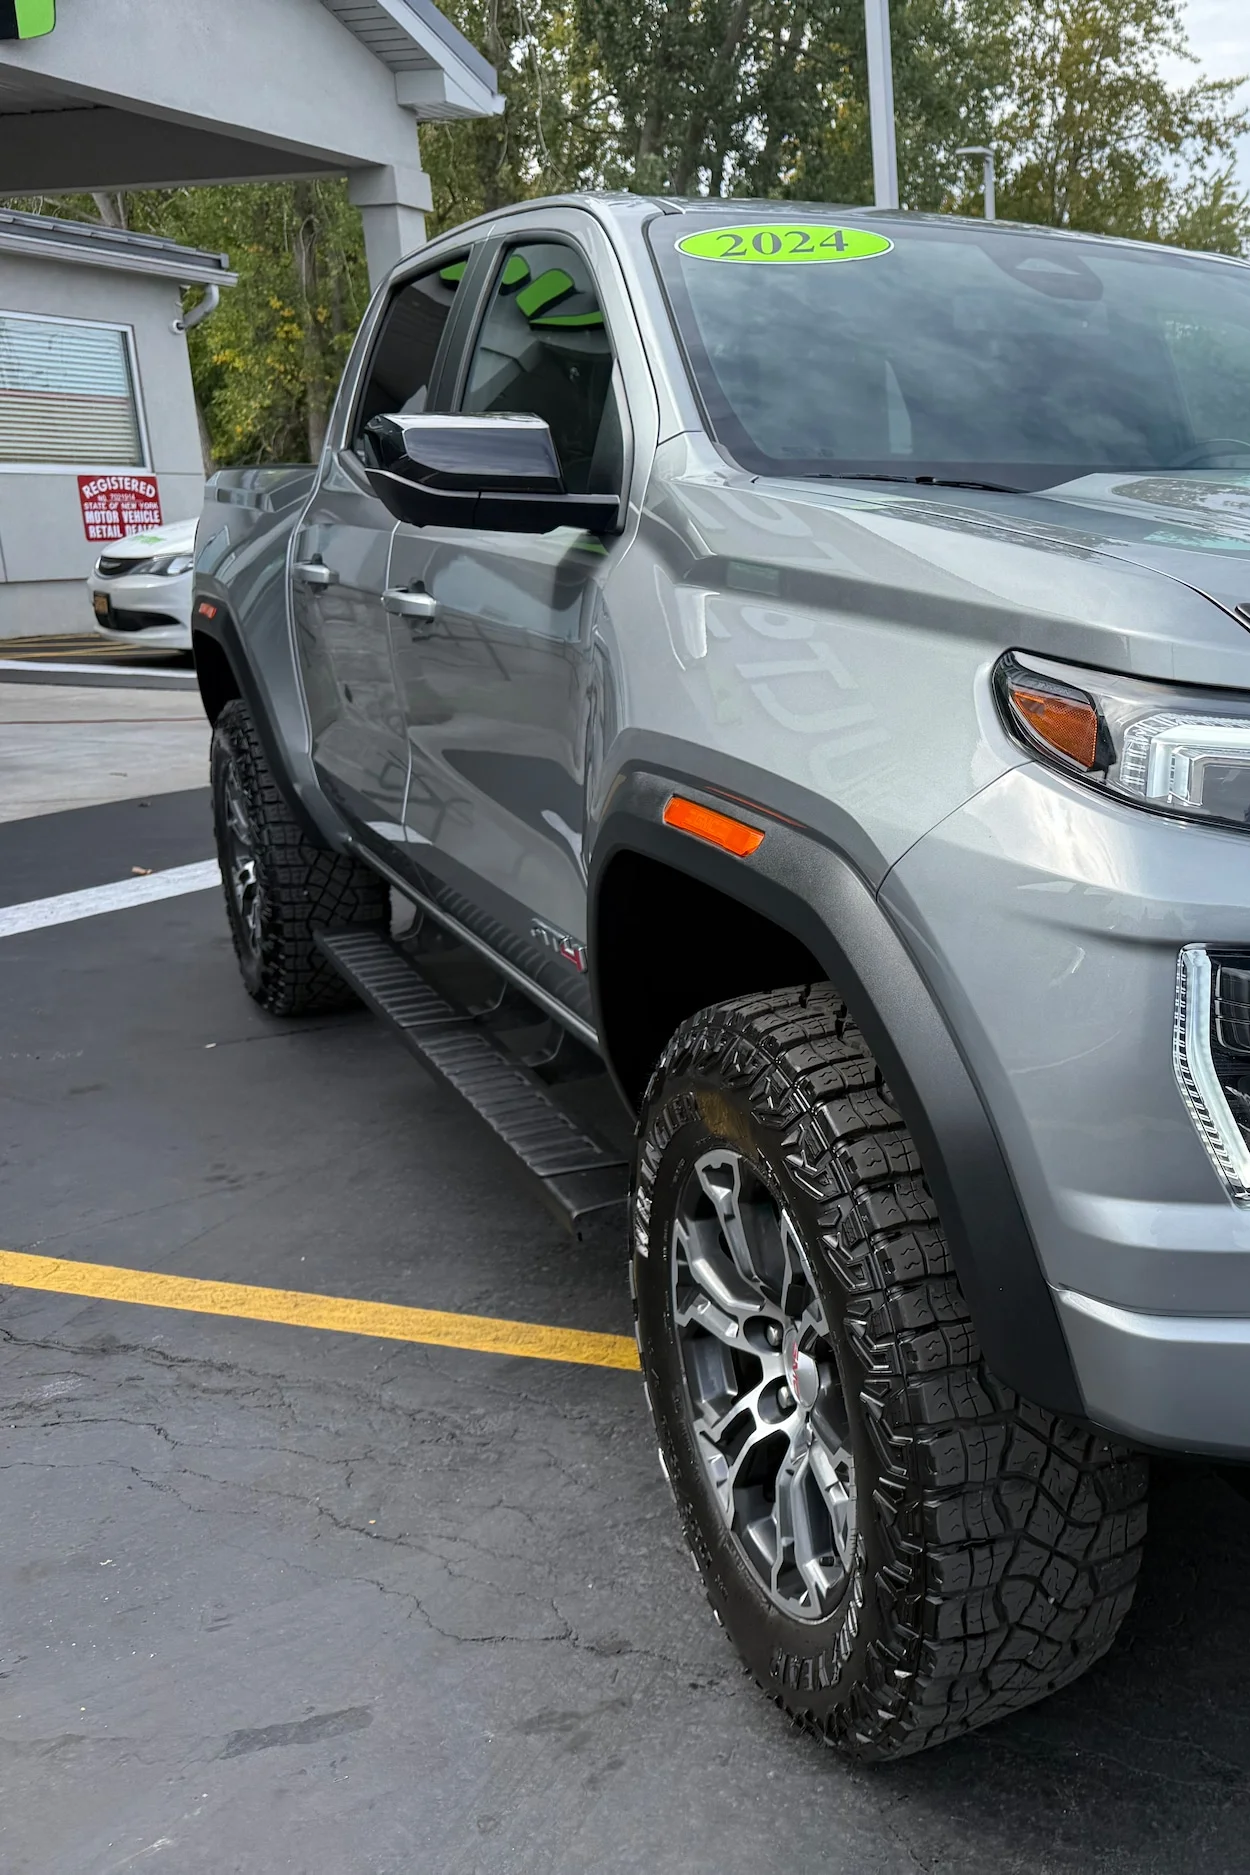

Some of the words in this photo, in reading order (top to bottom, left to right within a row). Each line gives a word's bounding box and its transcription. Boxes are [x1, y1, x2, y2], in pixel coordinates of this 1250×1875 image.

[716, 229, 849, 258] 2024
[82, 476, 155, 499] REGISTERED
[84, 502, 107, 510] STATE
[121, 502, 137, 510] NEW
[84, 510, 120, 524] MOTOR
[122, 510, 160, 524] VEHICLE
[88, 525, 123, 538] RETAIL
